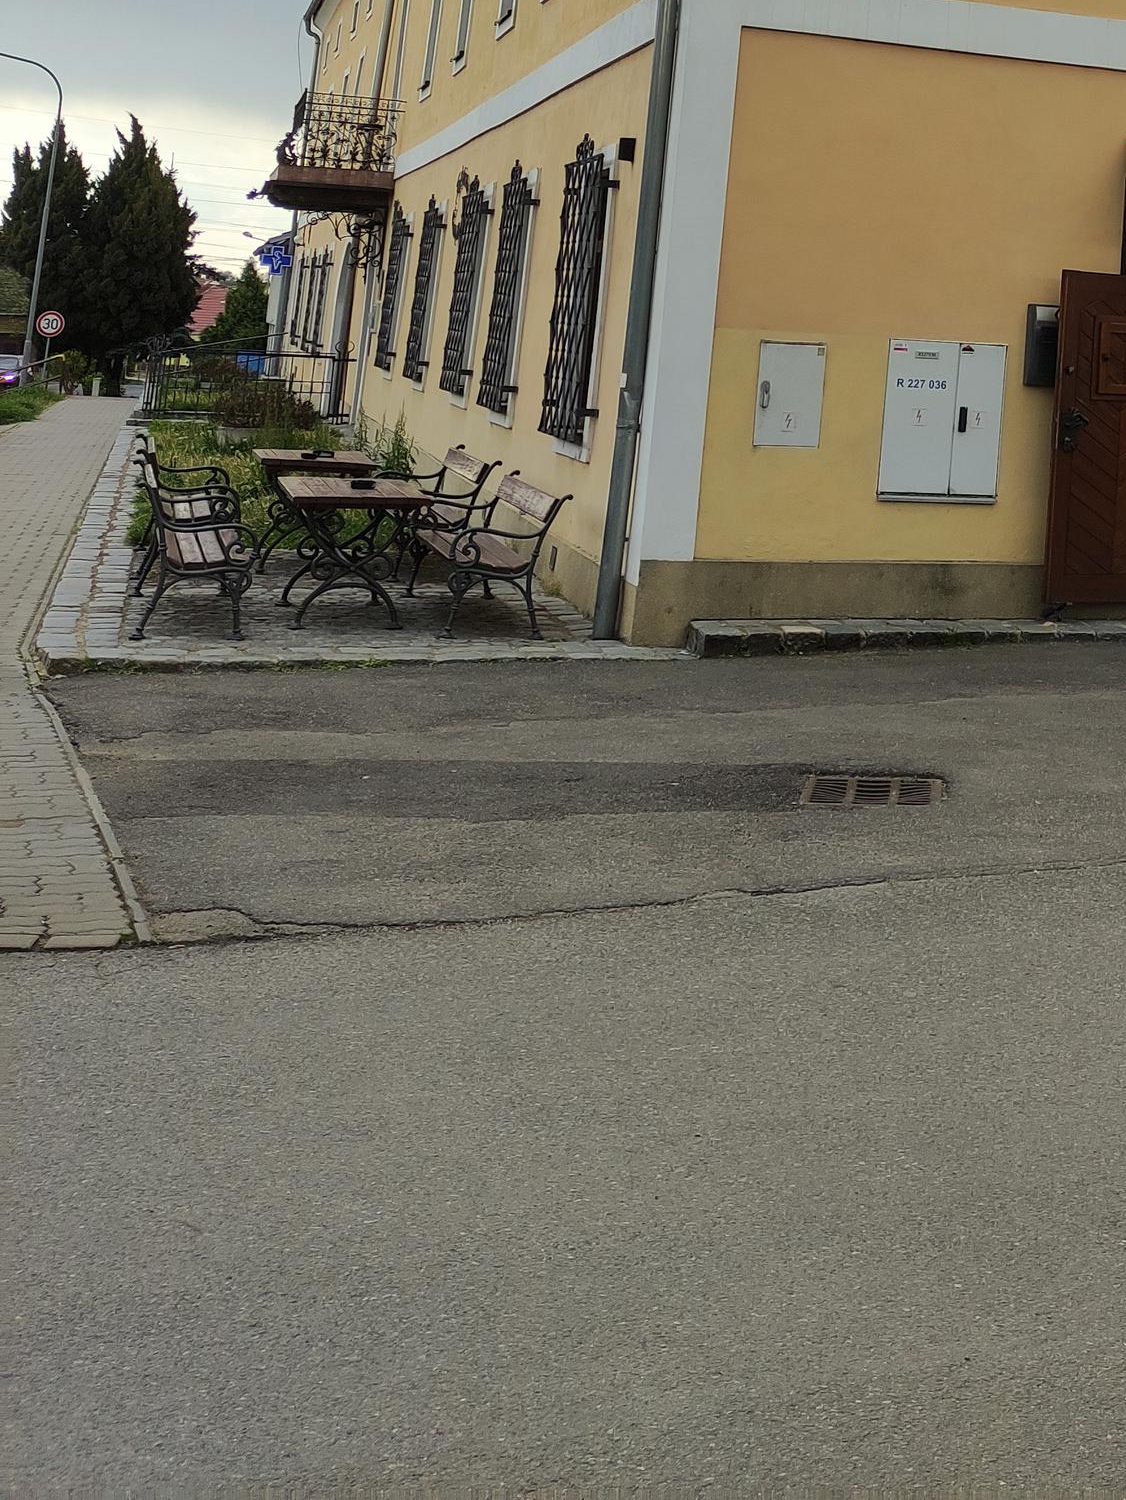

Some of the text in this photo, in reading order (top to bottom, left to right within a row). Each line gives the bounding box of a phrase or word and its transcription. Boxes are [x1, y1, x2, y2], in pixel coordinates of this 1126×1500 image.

[42, 318, 59, 330] 30
[896, 378, 947, 390] R 227 036
